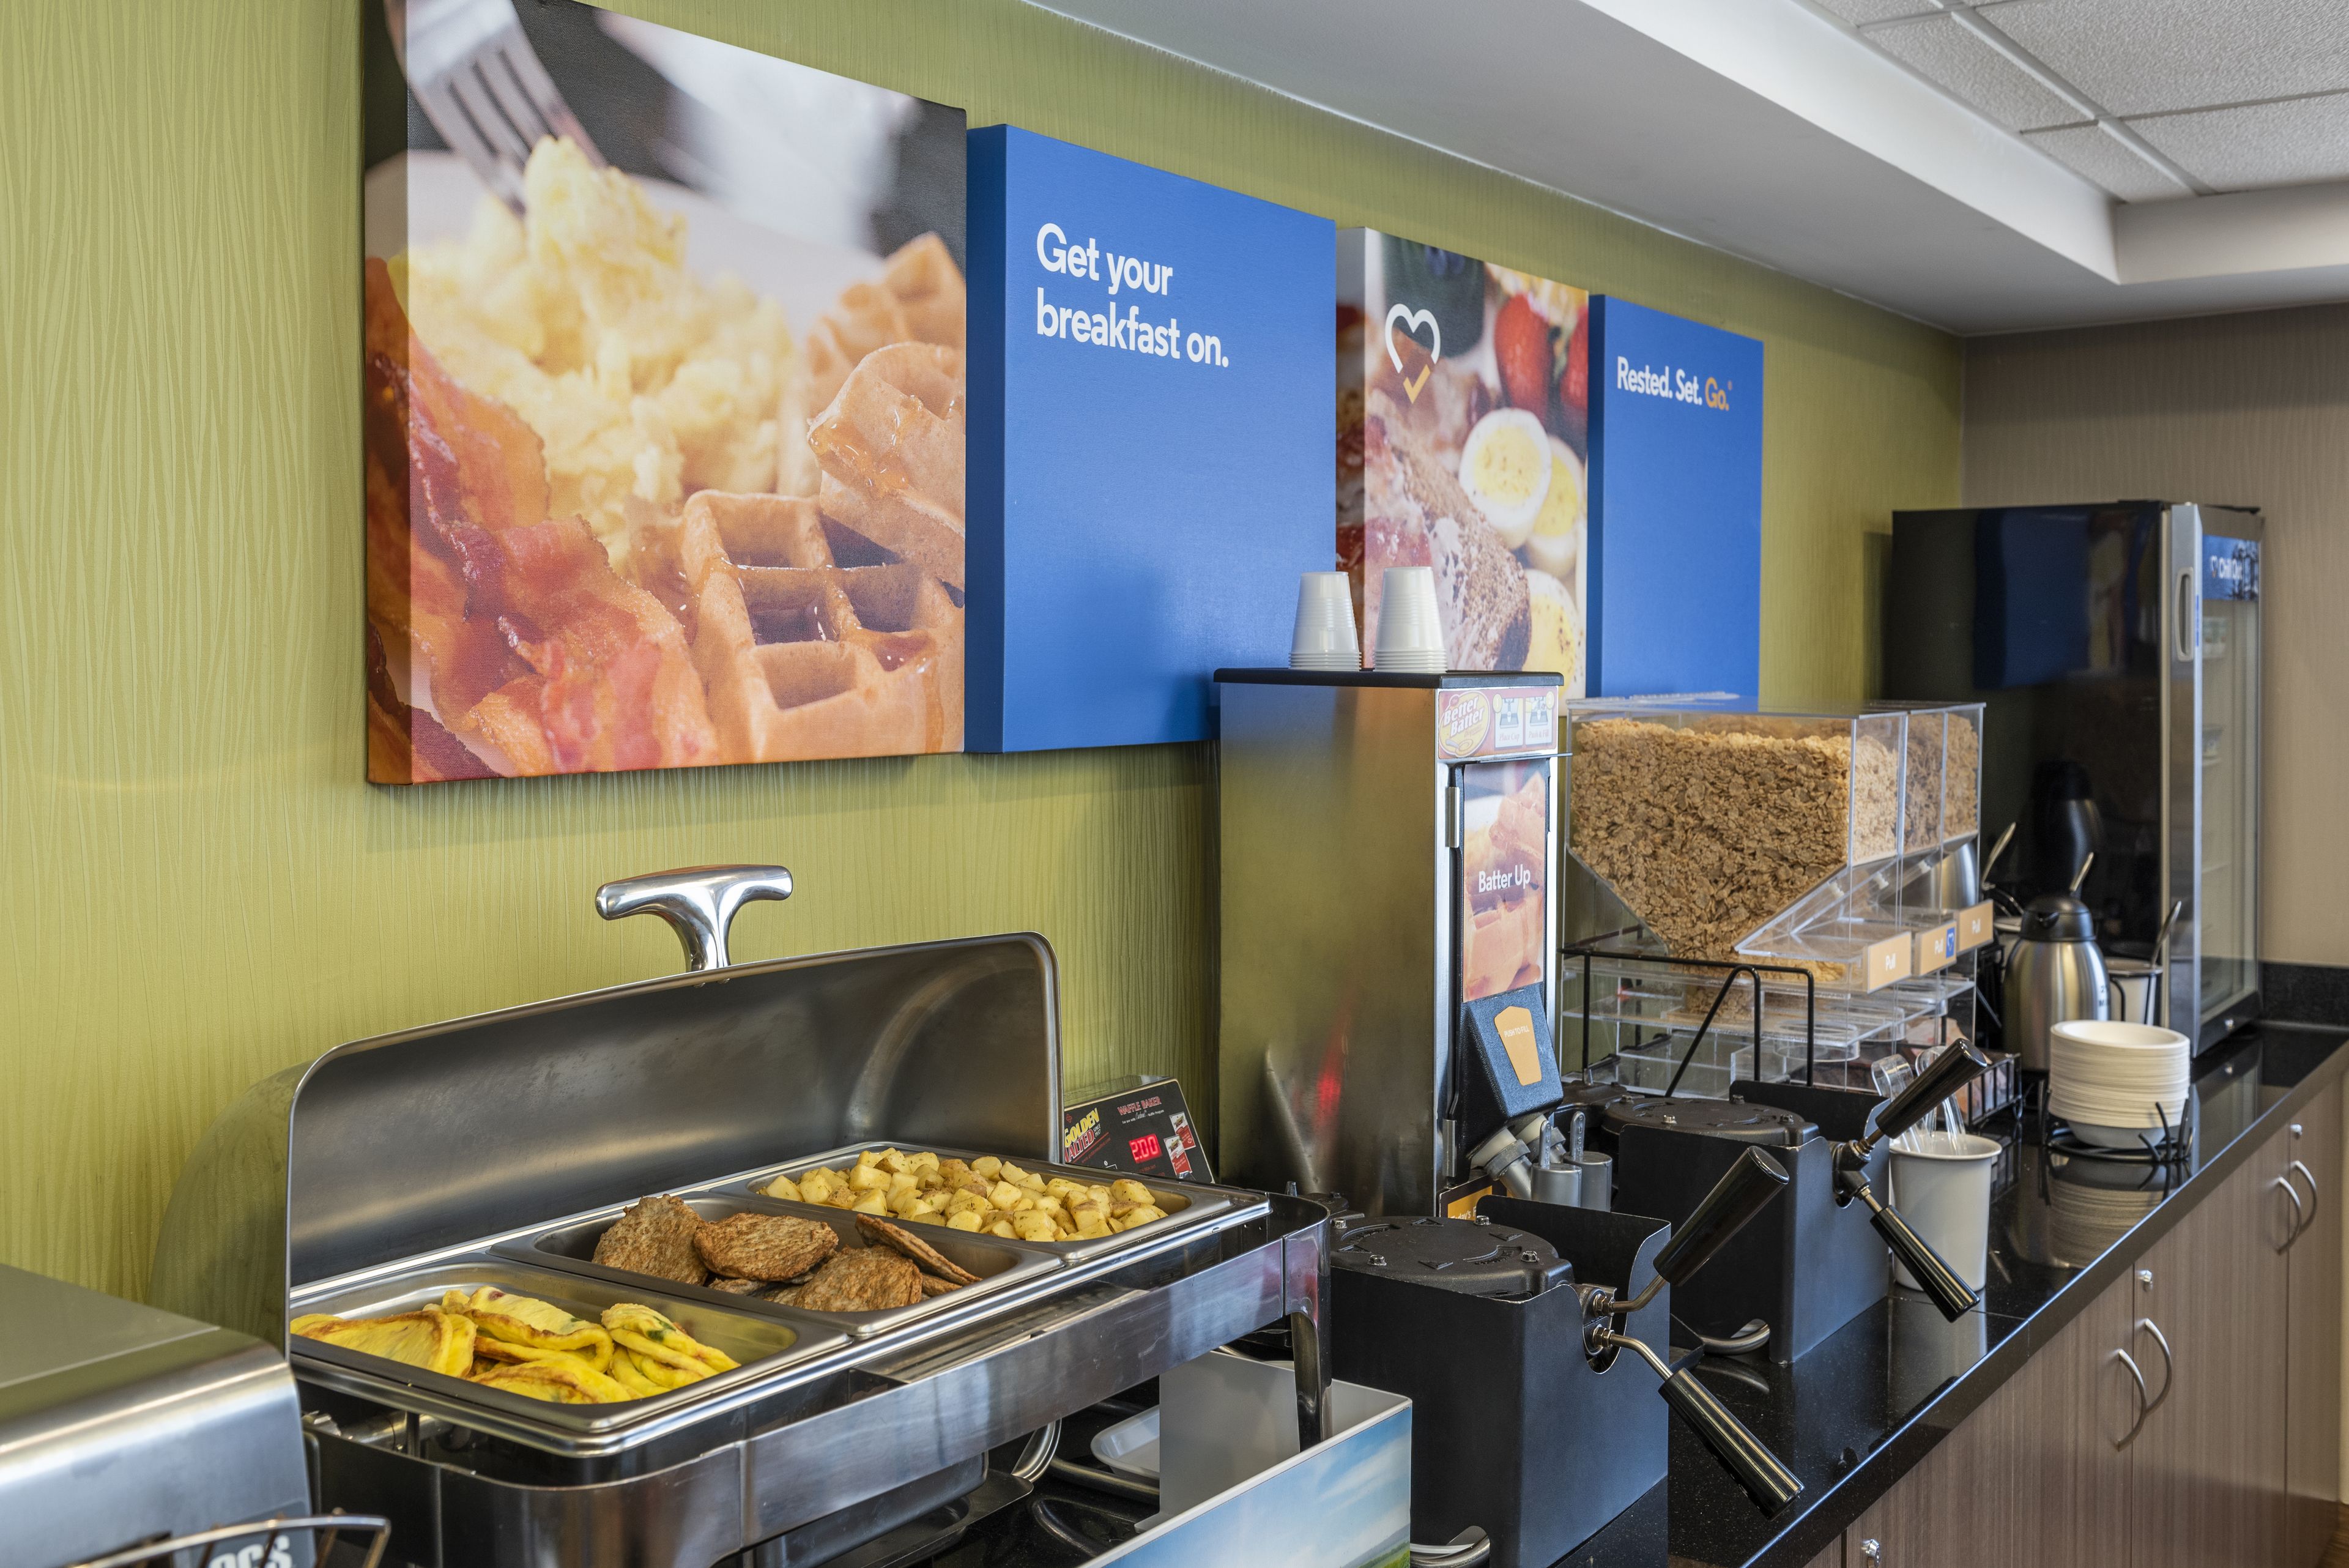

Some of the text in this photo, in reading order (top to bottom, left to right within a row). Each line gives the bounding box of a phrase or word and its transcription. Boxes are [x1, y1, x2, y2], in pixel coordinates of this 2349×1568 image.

[1037, 223, 1173, 296] Get your
[1037, 287, 1229, 368] breakfast on.
[1617, 355, 1673, 399] Rested.
[1675, 368, 1702, 406] Set.
[1443, 695, 1479, 727] Better
[1450, 707, 1485, 738] Batter
[1479, 864, 1531, 893] Batter Up
[1972, 919, 1981, 934] Pull
[1935, 938, 1943, 954] Pull
[1885, 953, 1896, 971] Pull
[1504, 1029, 1515, 1038] PUSH
[1521, 1025, 1530, 1033] FILL
[1117, 1096, 1162, 1116] WAFFLE BAKER
[1064, 1107, 1100, 1148] GOLDEN
[1131, 1136, 1159, 1161] 2:00
